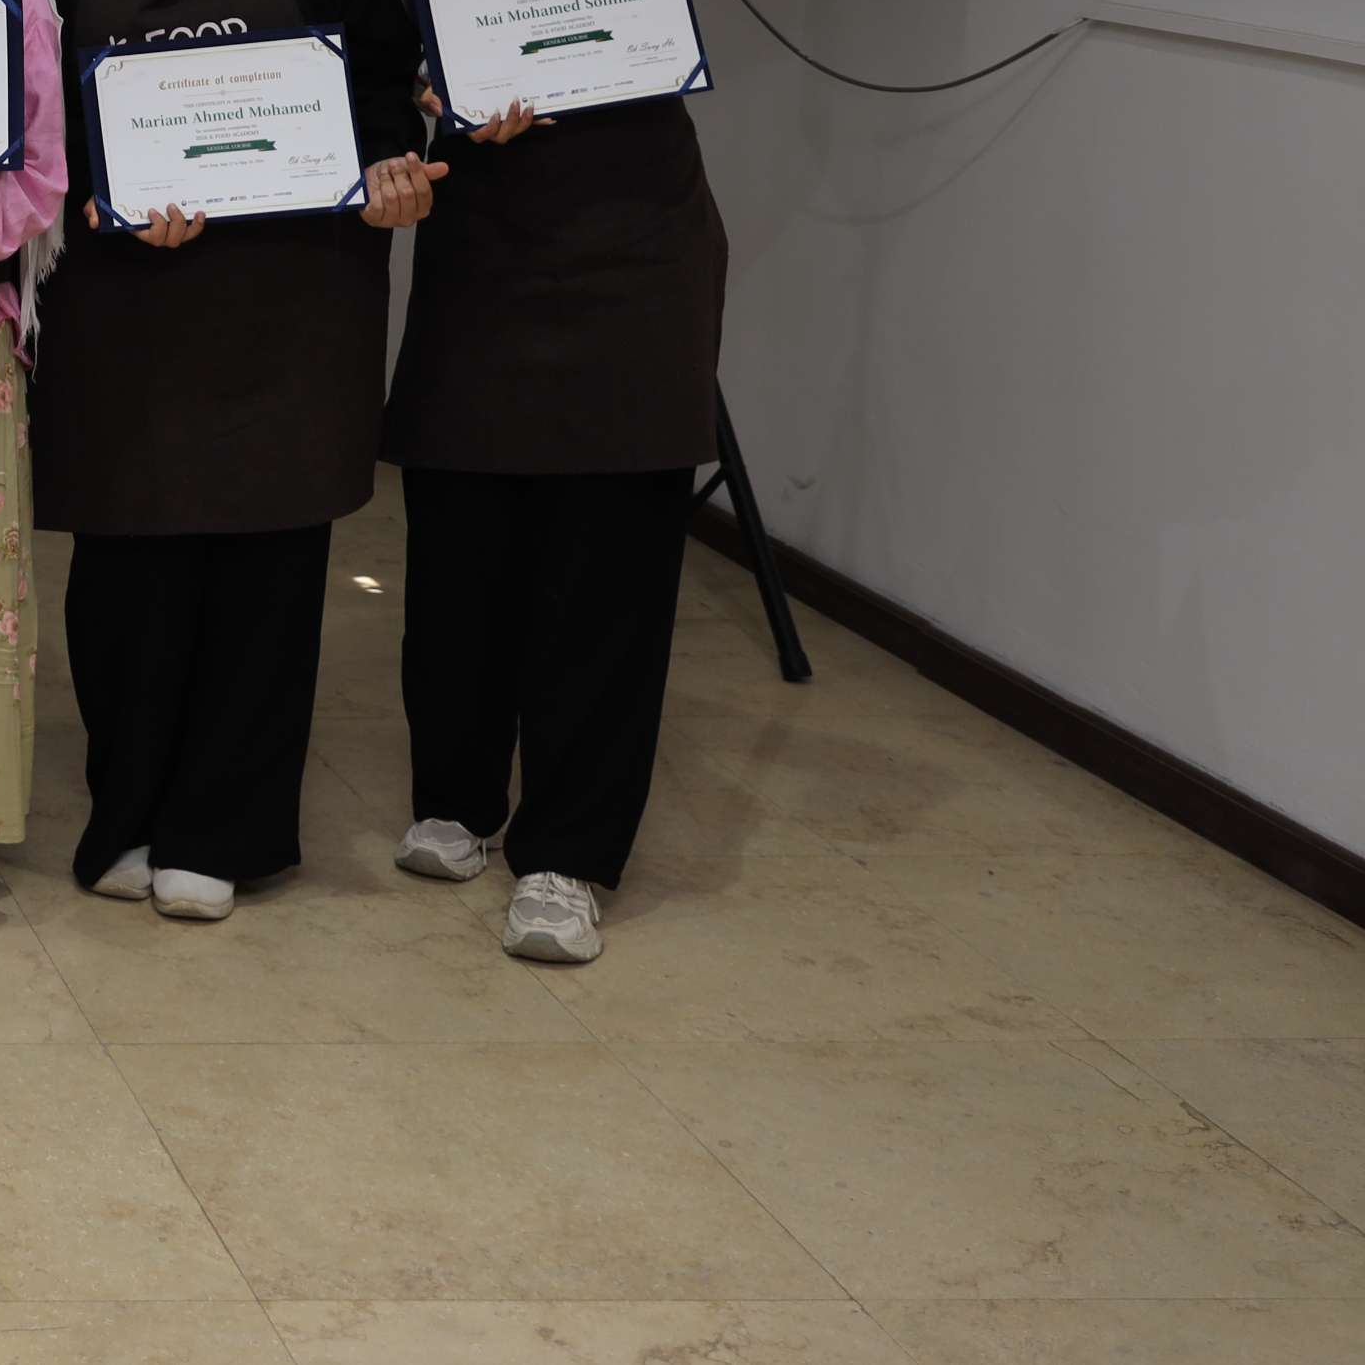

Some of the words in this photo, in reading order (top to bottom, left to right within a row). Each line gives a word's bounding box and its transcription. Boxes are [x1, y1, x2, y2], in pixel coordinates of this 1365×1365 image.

[475, 12, 502, 27] Mai
[157, 75, 211, 91] Certificate
[213, 74, 225, 85] of
[229, 67, 283, 83] completion
[131, 114, 187, 129] Mariam
[192, 106, 243, 123] Ahmed
[248, 99, 321, 117] Mohamed
